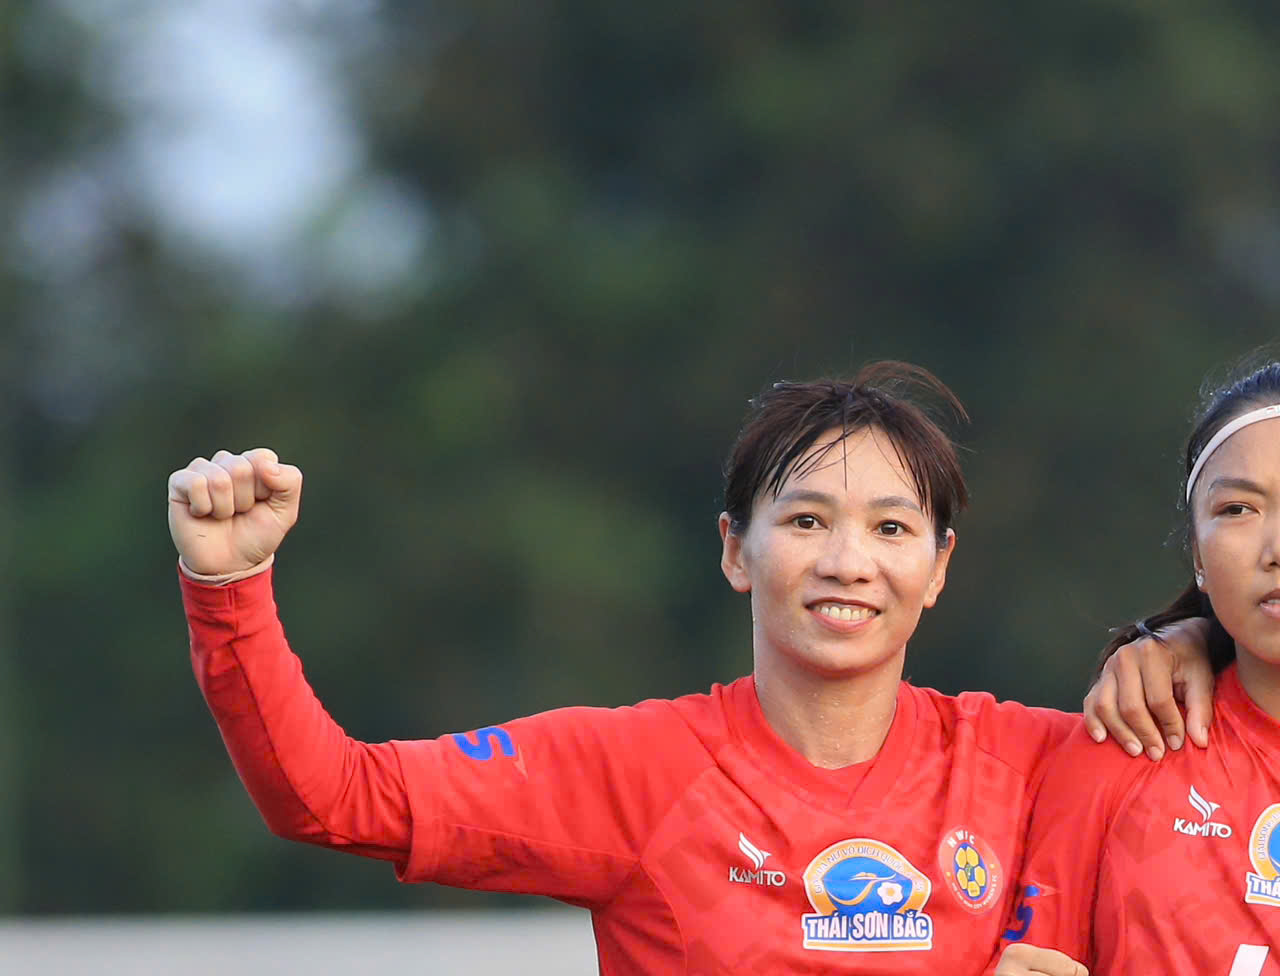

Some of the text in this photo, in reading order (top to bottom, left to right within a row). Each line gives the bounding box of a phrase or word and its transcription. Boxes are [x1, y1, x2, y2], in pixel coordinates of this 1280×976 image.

[1173, 817, 1233, 839] KAMITO
[729, 866, 786, 886] KAMITO
[807, 910, 929, 939] THÁI SƠN BẮC
